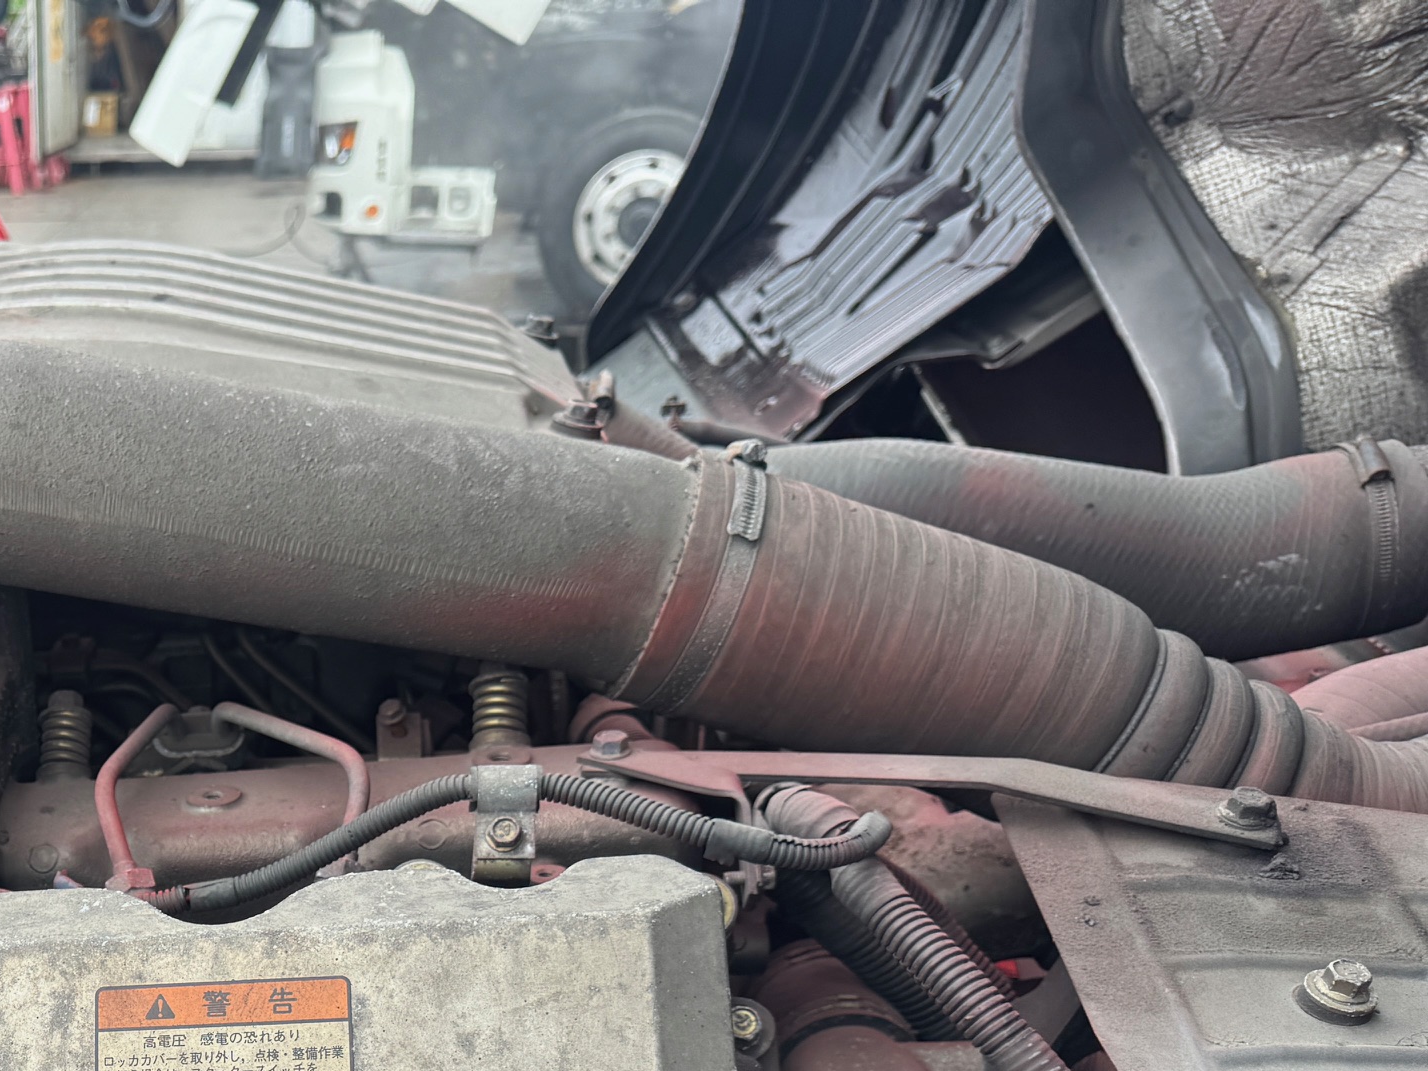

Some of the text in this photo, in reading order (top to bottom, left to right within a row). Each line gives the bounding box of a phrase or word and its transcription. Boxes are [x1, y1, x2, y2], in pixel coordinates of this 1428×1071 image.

[203, 987, 297, 1018] 警告
[143, 1029, 300, 1049] 高電圧 感電の恐れあり
